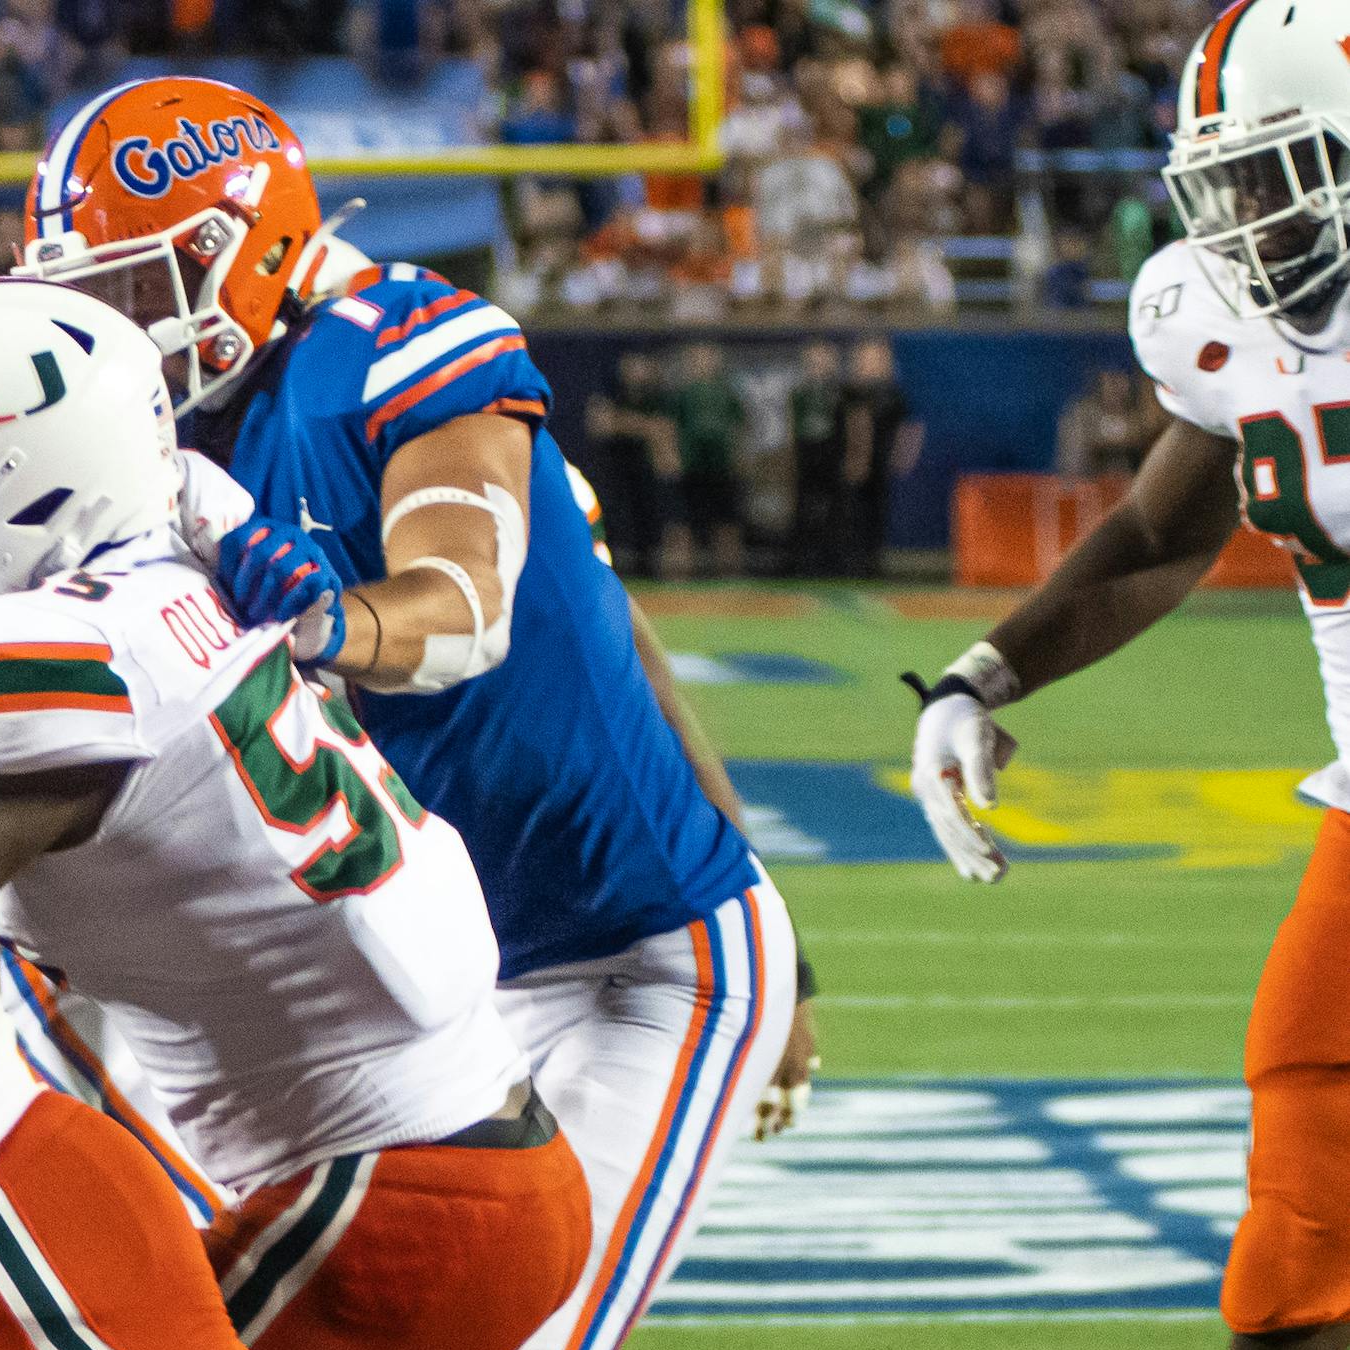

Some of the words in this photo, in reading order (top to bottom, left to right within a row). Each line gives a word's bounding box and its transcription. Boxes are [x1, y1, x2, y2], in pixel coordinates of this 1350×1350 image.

[111, 115, 281, 199] Gators
[1237, 401, 1350, 606] 9
[208, 632, 430, 905] 5
